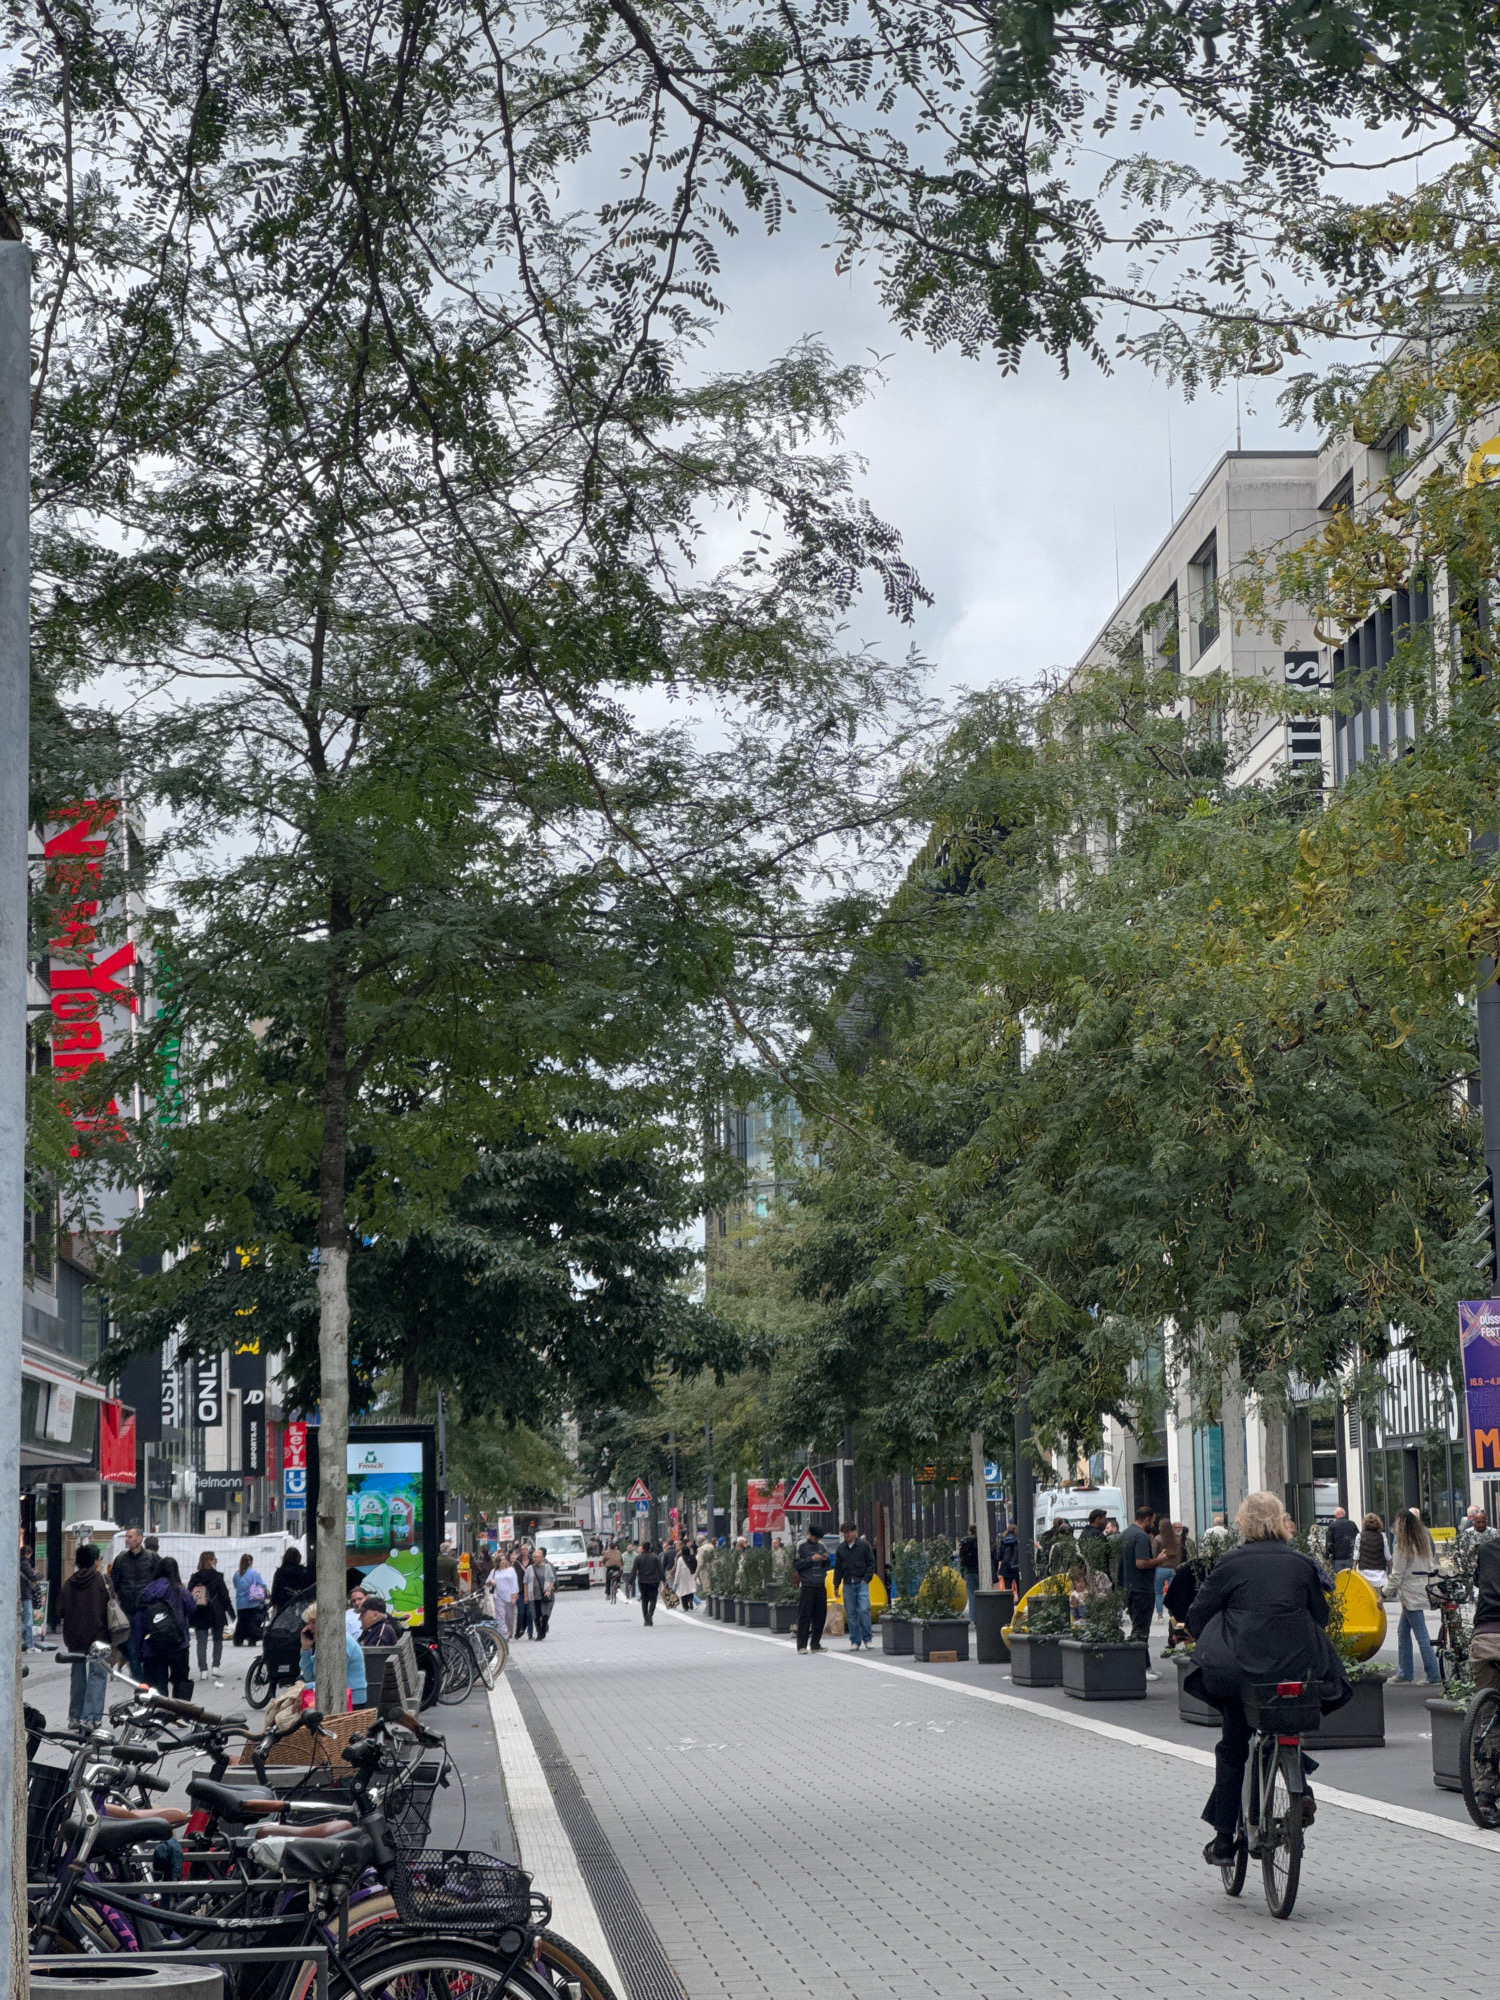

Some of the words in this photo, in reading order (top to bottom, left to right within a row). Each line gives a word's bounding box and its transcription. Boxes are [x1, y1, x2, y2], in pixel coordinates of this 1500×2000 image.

[1479, 1314, 1500, 1325] DÜSS
[198, 1347, 217, 1422] ONLY
[244, 1390, 264, 1405] JD
